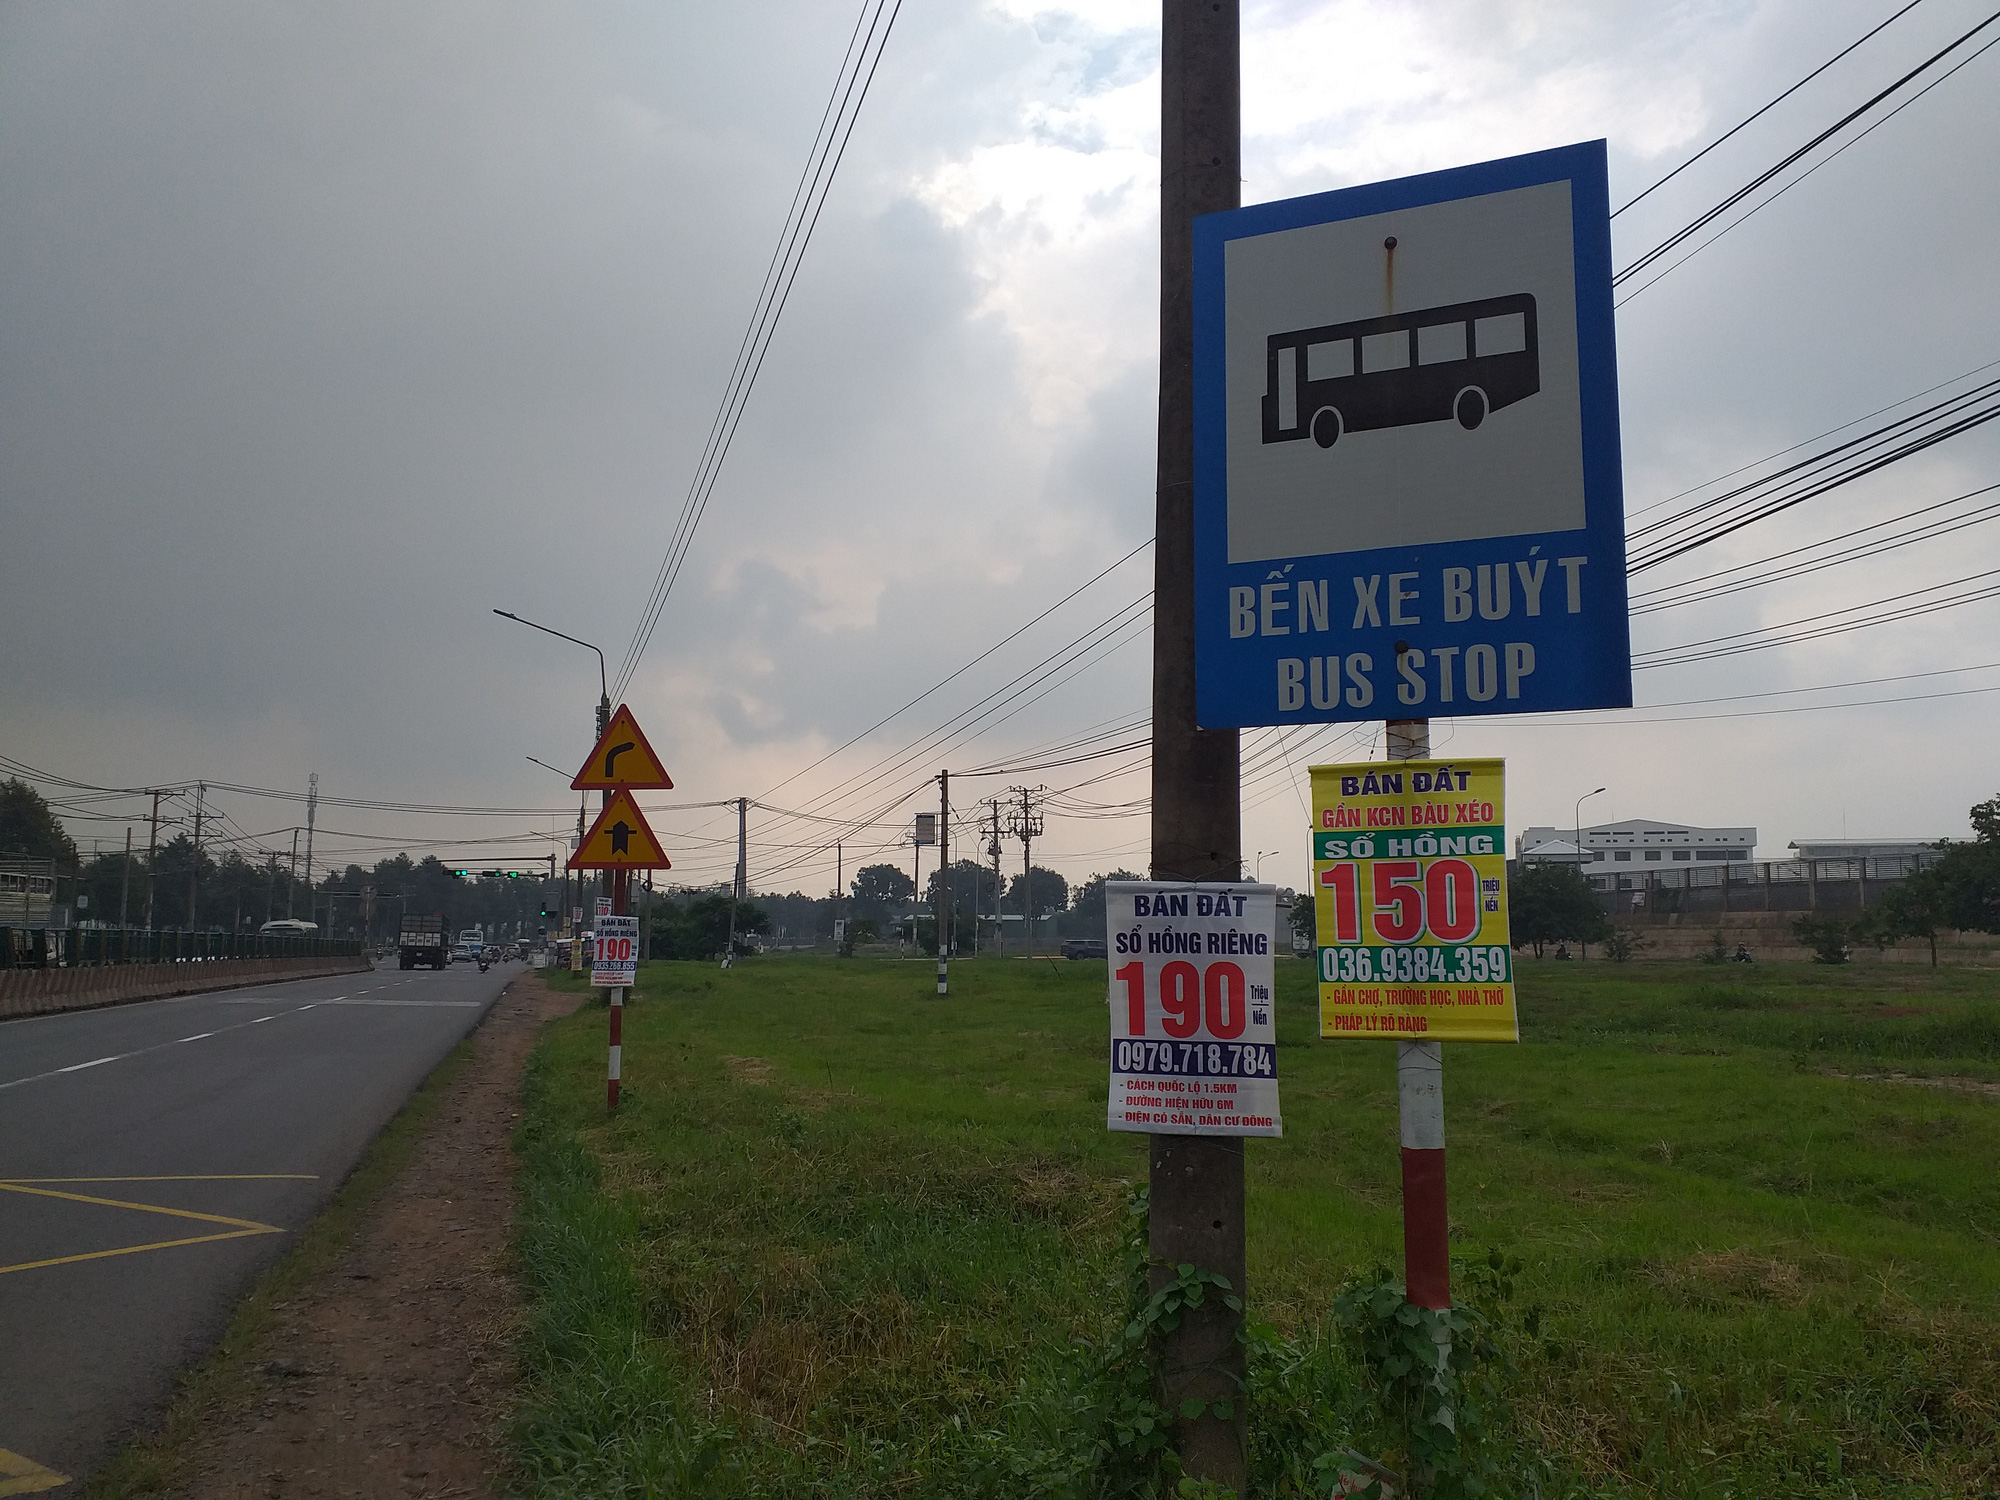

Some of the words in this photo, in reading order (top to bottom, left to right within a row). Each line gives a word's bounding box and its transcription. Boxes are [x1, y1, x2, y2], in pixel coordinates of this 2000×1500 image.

[1229, 564, 1329, 638] BẾN
[1352, 572, 1420, 629] XE
[1443, 545, 1588, 623] BUÝT
[1277, 653, 1374, 712] BUS
[1397, 642, 1536, 706] STOP
[1341, 770, 1403, 796] BÁN
[1412, 764, 1471, 793] ĐẤT
[1322, 802, 1361, 828] GẦN
[1367, 806, 1405, 827] KCN
[1411, 801, 1449, 825] BÀU
[1455, 799, 1493, 823] XÉO
[1325, 832, 1376, 858] SỔ
[1388, 831, 1494, 857] HỒNG
[1134, 891, 1188, 917] BÁN
[1196, 888, 1247, 917] ĐẤT
[1320, 859, 1480, 944] 150
[597, 938, 631, 961] 190
[1116, 924, 1142, 954] SỔ
[1149, 925, 1201, 954] HỒNG
[1208, 929, 1267, 955] RIÊNG
[1323, 947, 1506, 982] 036.9384.359
[1116, 960, 1246, 1040] 190
[1250, 985, 1269, 1003] Triệu
[1334, 985, 1355, 1005] GẦN
[1458, 987, 1480, 1006] NHÀ
[1335, 1013, 1363, 1031] PHÁP
[1366, 1013, 1378, 1031] LÝ
[1398, 1013, 1428, 1032] RÀNG
[1118, 1041, 1272, 1075] 0979.718.784
[1127, 1079, 1155, 1091] CÁCH
[1204, 1083, 1237, 1094] 1.5KM
[1125, 1111, 1150, 1125] ĐIỆN
[1242, 1114, 1272, 1127] ĐÔNG
[1216, 1100, 1234, 1110] 6M
